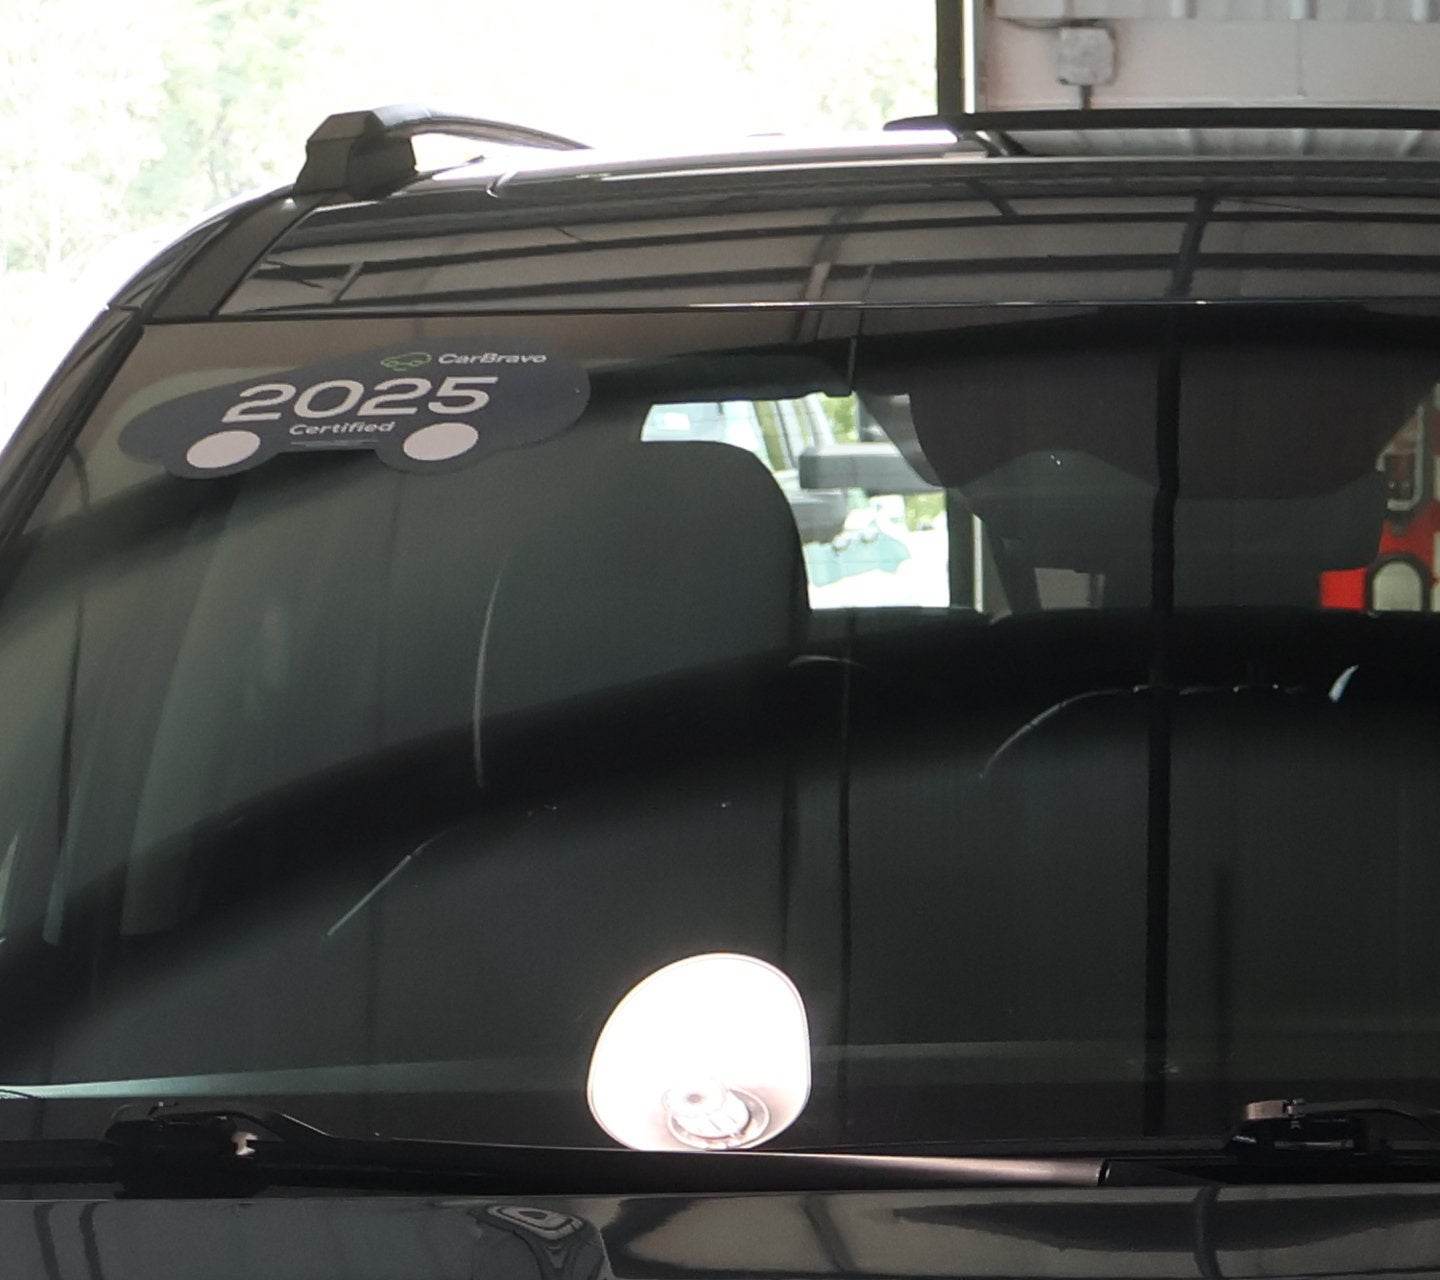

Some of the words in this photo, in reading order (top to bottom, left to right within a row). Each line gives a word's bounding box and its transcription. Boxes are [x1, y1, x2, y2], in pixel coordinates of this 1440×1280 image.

[437, 352, 548, 366] CarBravo
[221, 376, 500, 424] 2025
[288, 421, 396, 437] Certified
